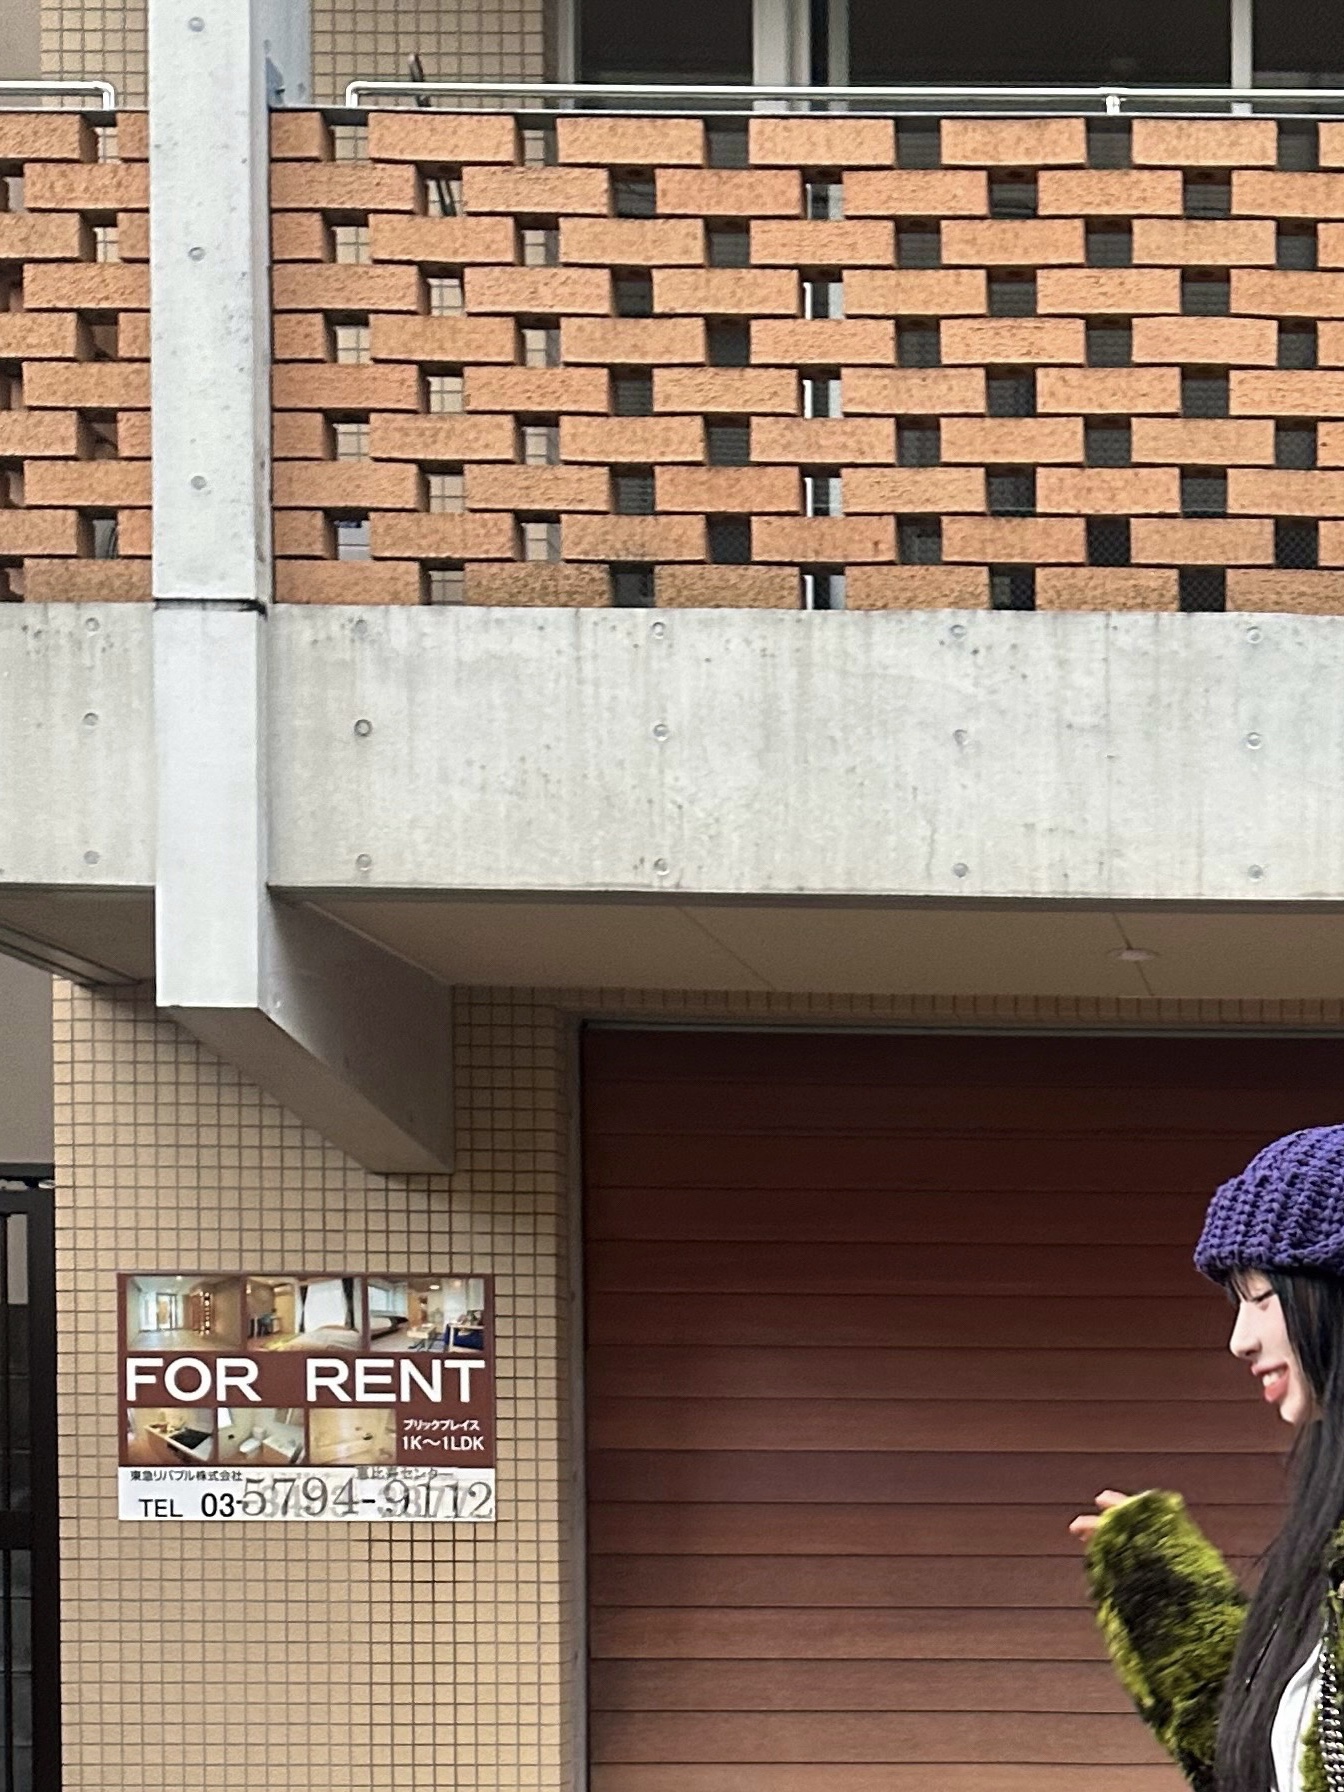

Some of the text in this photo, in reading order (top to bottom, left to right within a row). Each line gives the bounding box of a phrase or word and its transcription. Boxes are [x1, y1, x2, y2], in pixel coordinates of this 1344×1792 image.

[126, 1357, 485, 1402] FOR RENT
[139, 1499, 183, 1518] TEL
